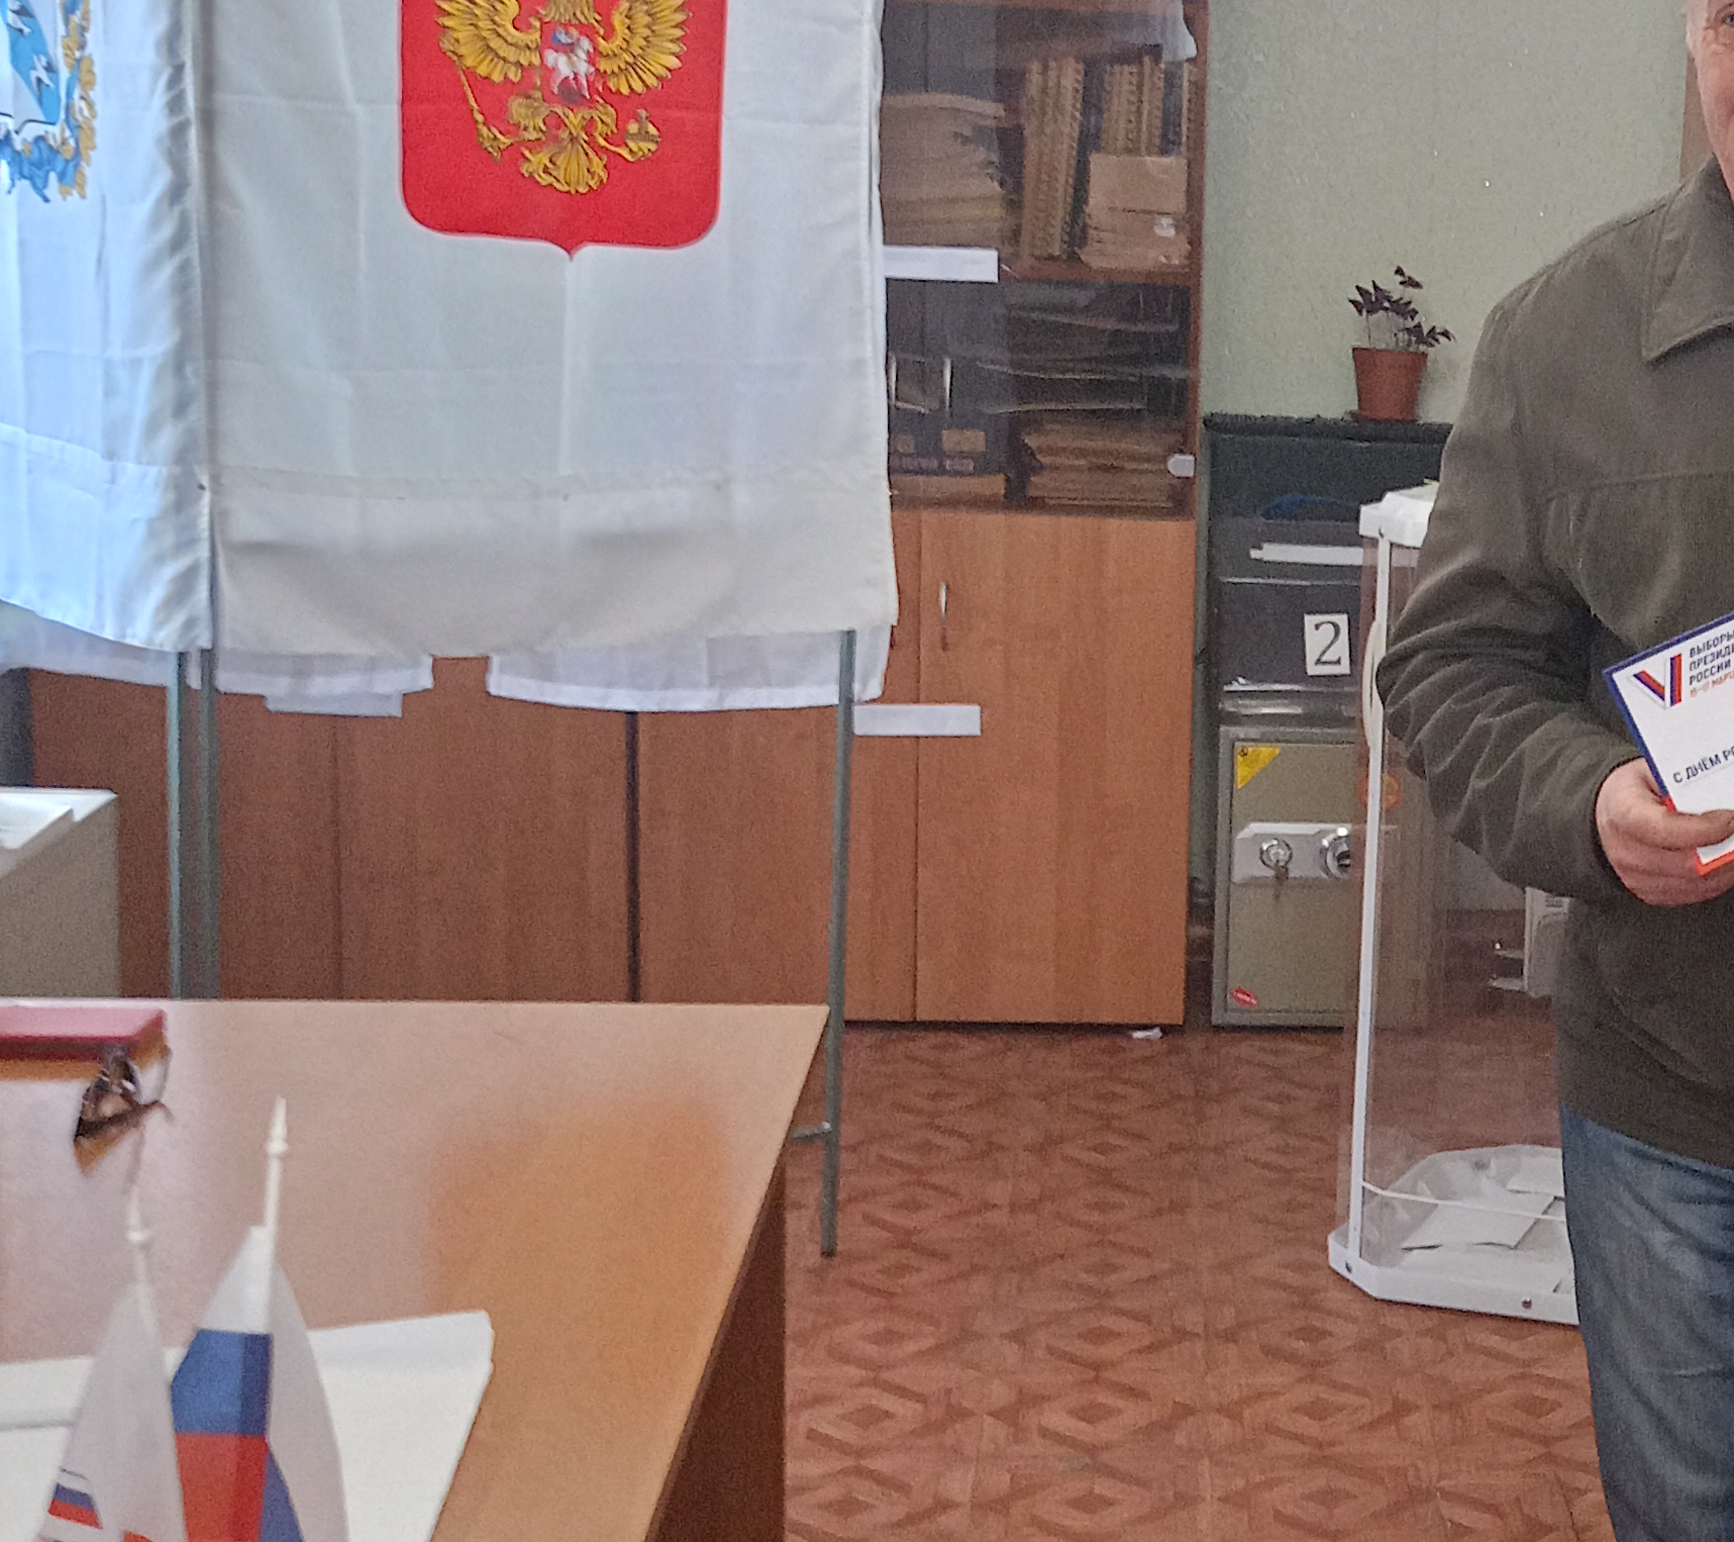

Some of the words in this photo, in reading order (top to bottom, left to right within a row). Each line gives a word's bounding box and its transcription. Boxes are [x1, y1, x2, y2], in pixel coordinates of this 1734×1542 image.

[1314, 621, 1341, 666] 2
[1689, 658, 1732, 686] РОССИИ
[1673, 772, 1683, 783] С
